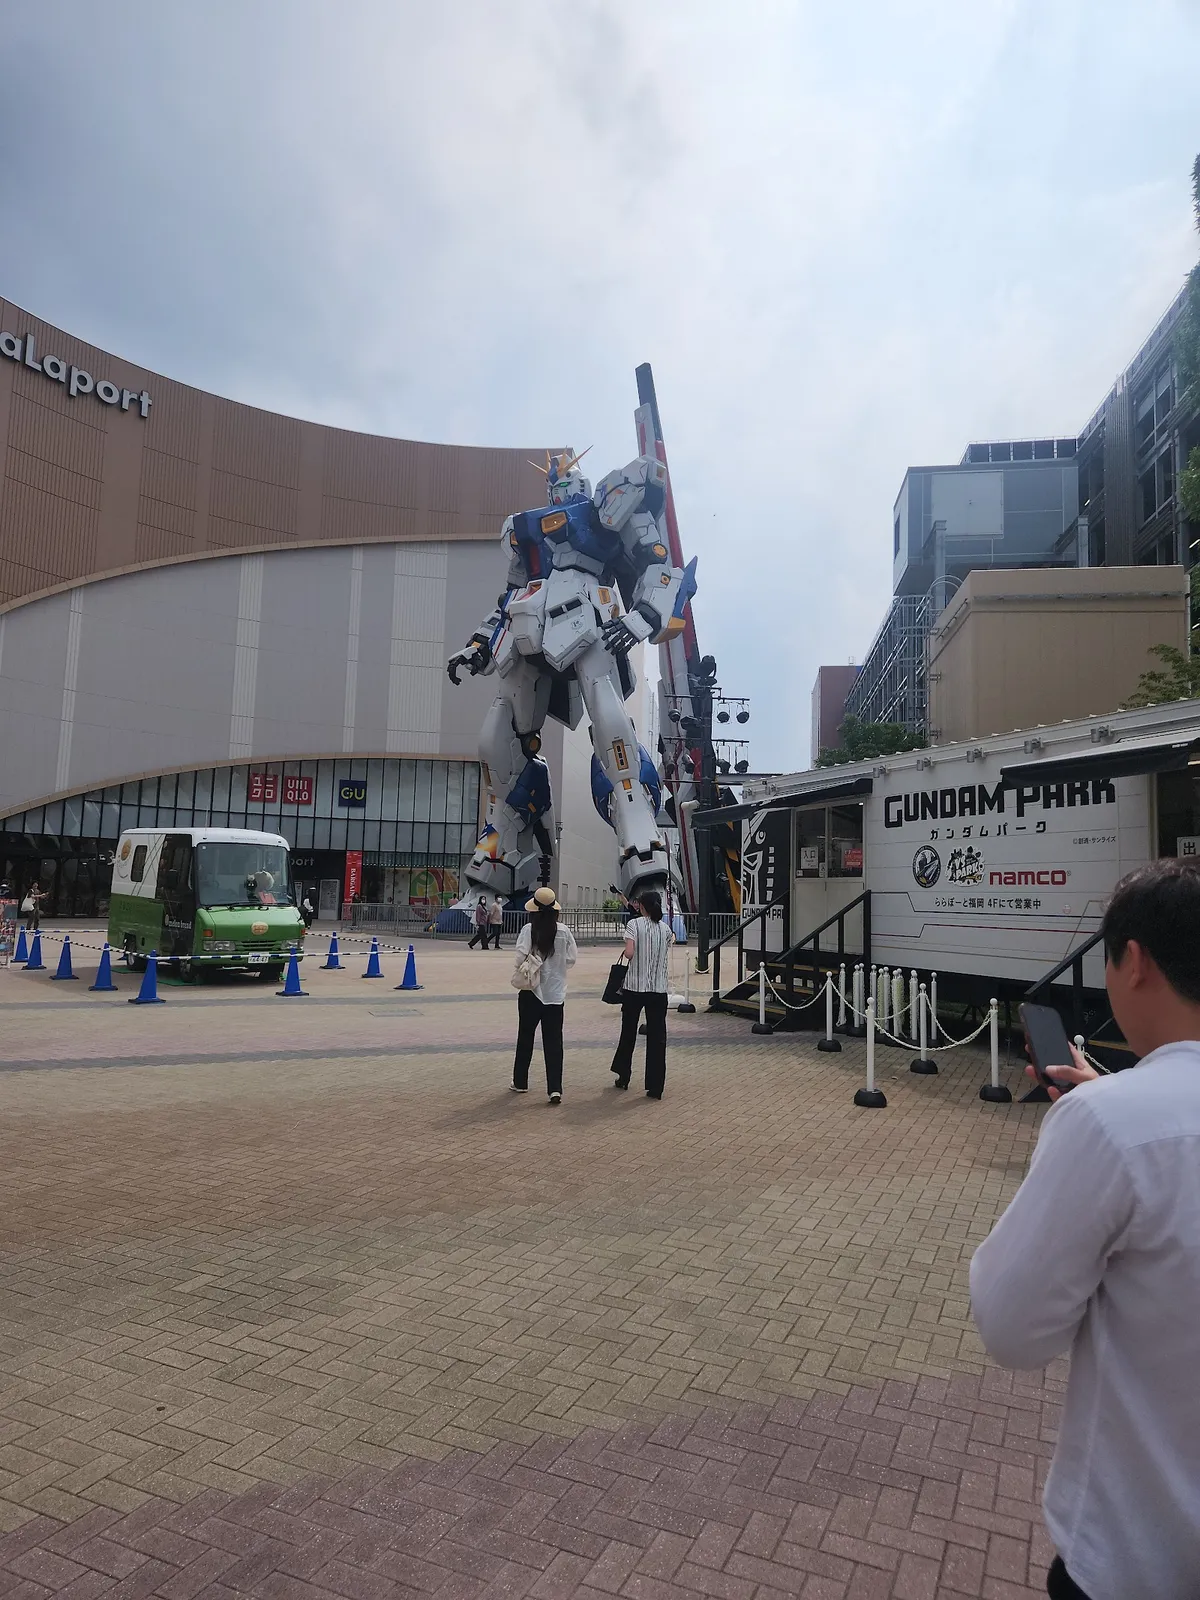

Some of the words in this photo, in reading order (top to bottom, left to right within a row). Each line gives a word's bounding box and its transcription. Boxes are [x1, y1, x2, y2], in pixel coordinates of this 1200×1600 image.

[253, 776, 274, 787] ユニ
[287, 779, 307, 790] UNI
[287, 790, 309, 802] QLO
[340, 787, 365, 800] GU
[885, 781, 1005, 828] GUNDAM
[1016, 777, 1116, 817] PARK
[930, 821, 1047, 840] ガンダムパーク
